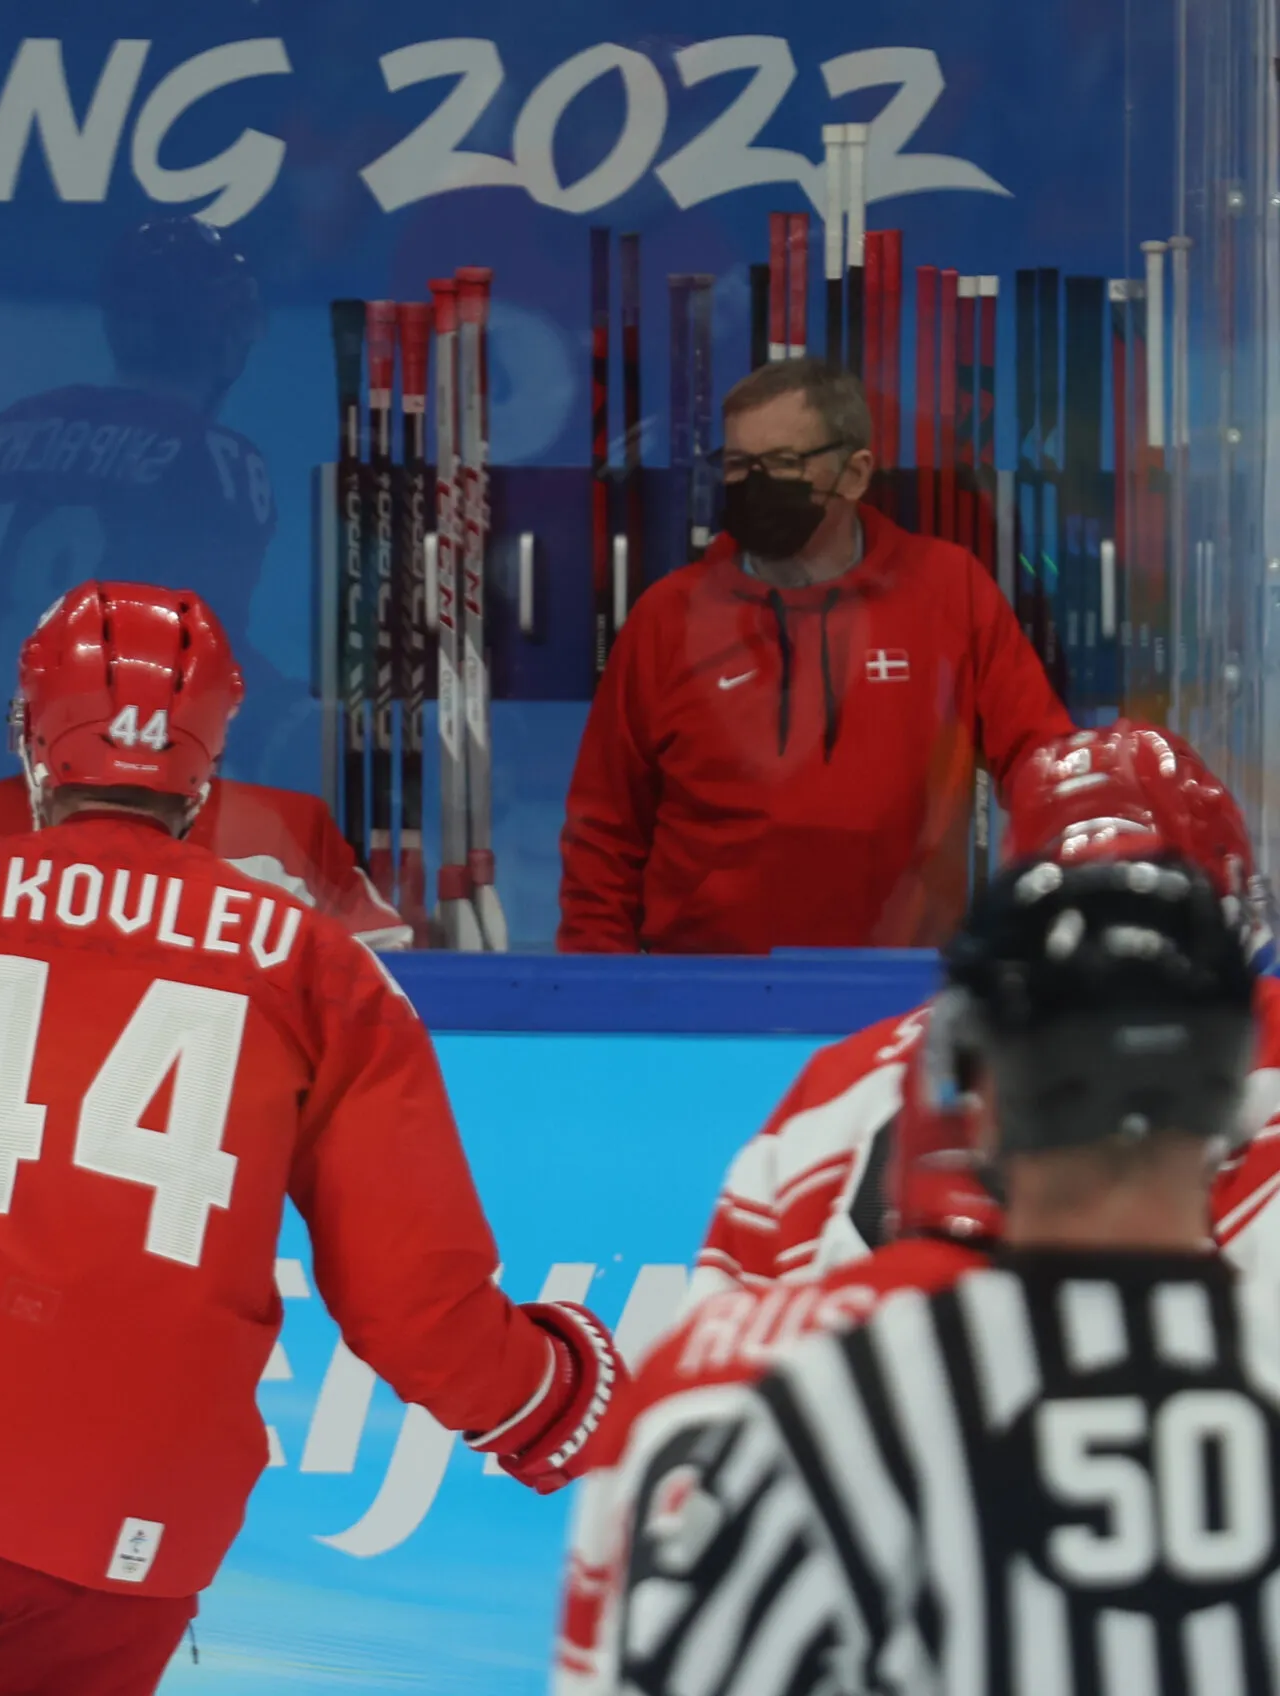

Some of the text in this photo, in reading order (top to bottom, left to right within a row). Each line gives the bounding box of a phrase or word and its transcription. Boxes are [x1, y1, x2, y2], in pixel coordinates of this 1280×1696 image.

[359, 34, 1015, 222] 2022
[108, 704, 168, 750] 44
[1036, 1389, 1269, 1588] 50
